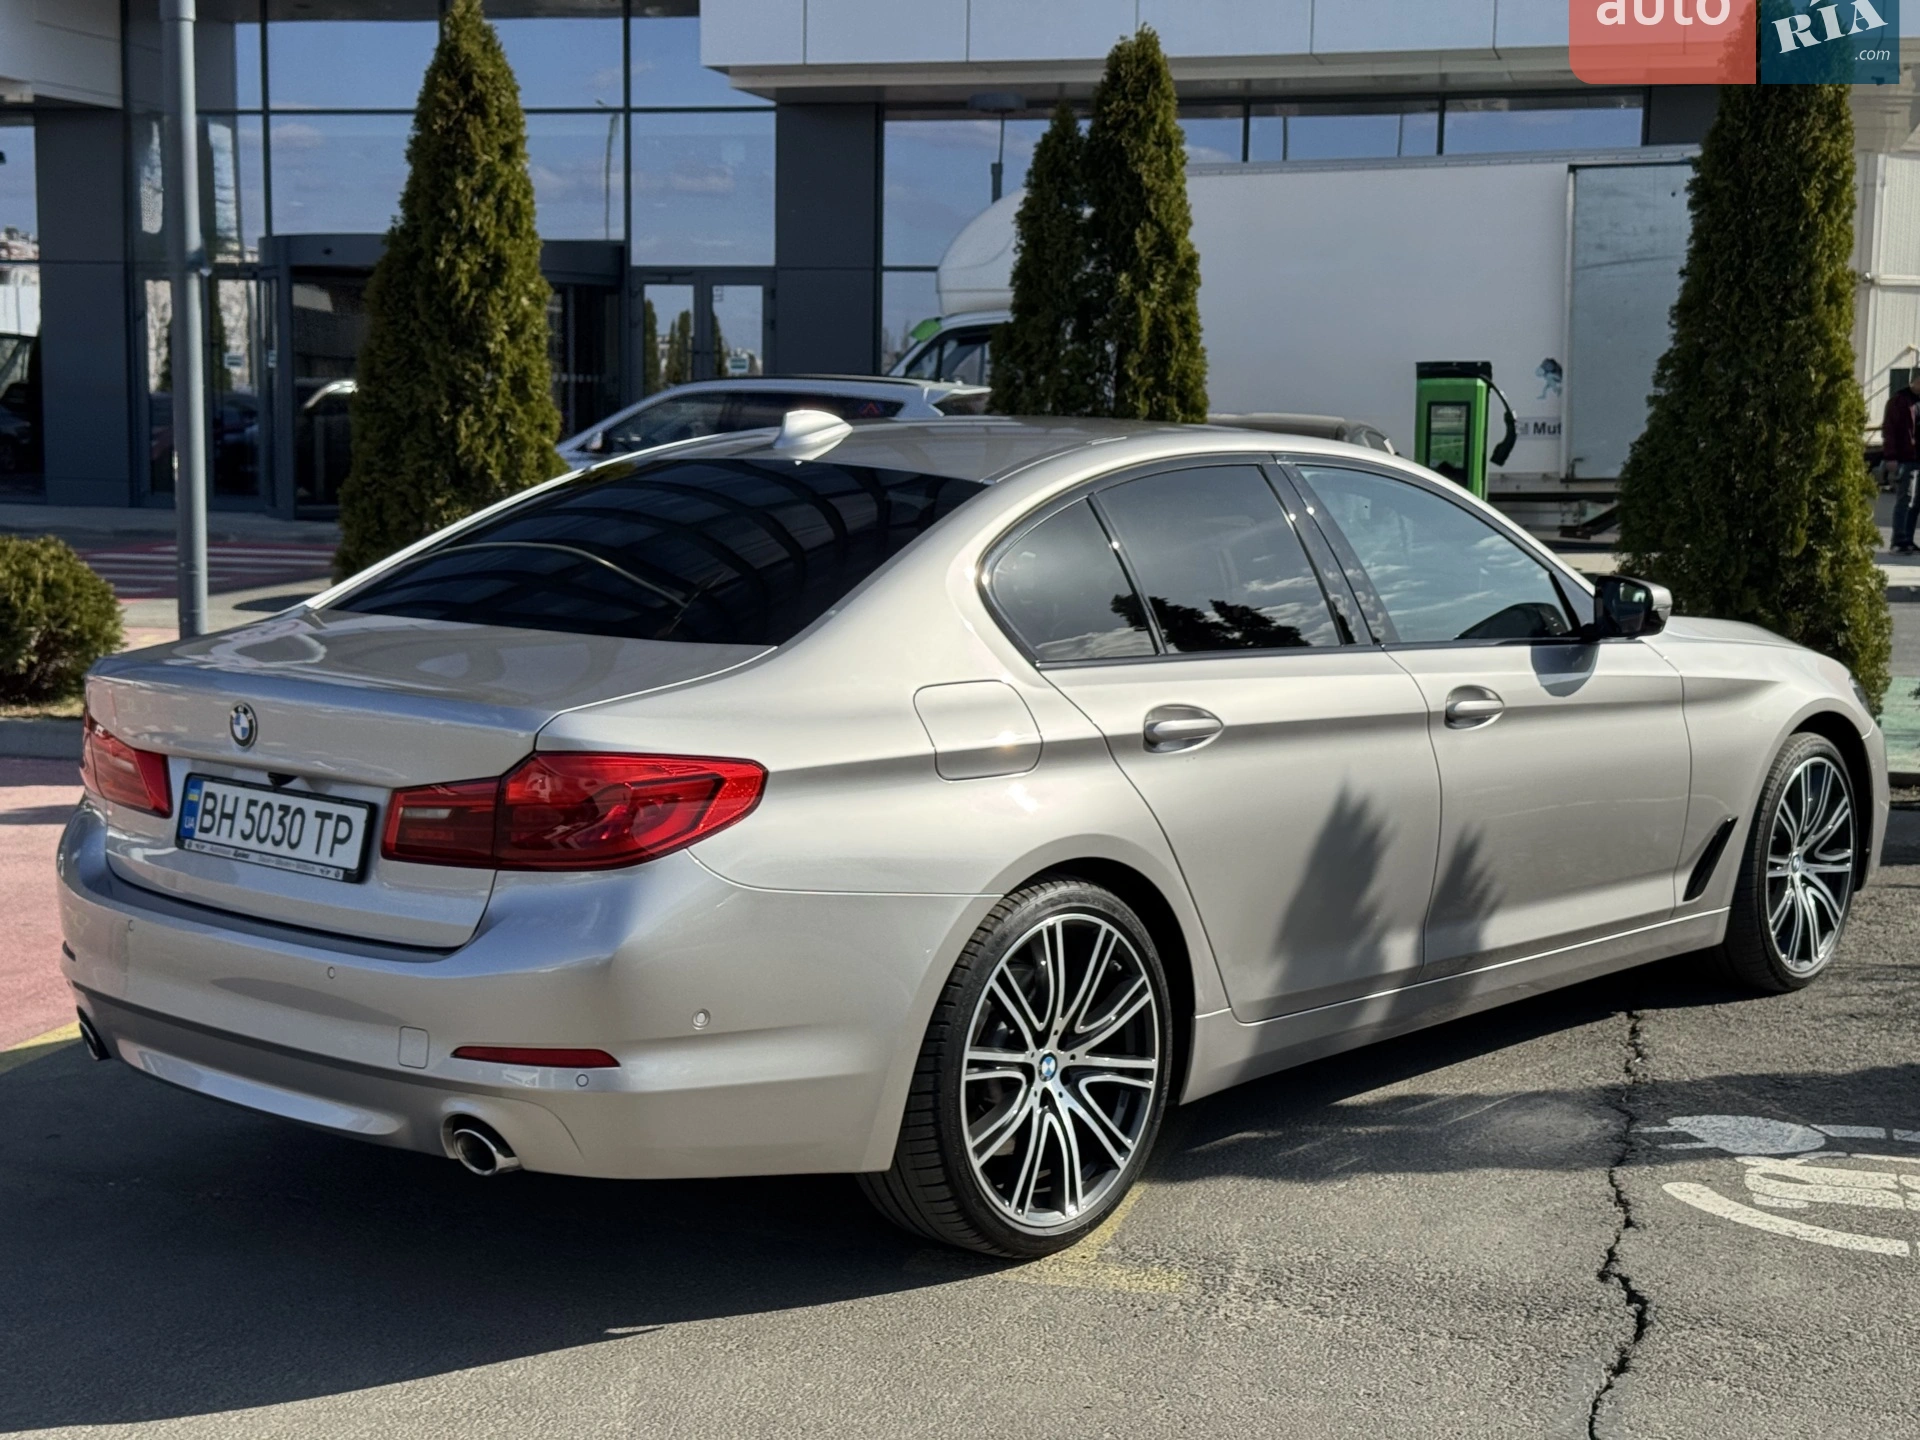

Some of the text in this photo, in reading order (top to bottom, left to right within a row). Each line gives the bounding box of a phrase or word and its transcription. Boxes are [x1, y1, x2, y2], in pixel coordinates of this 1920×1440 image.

[198, 790, 353, 858] BH 5030 TP
